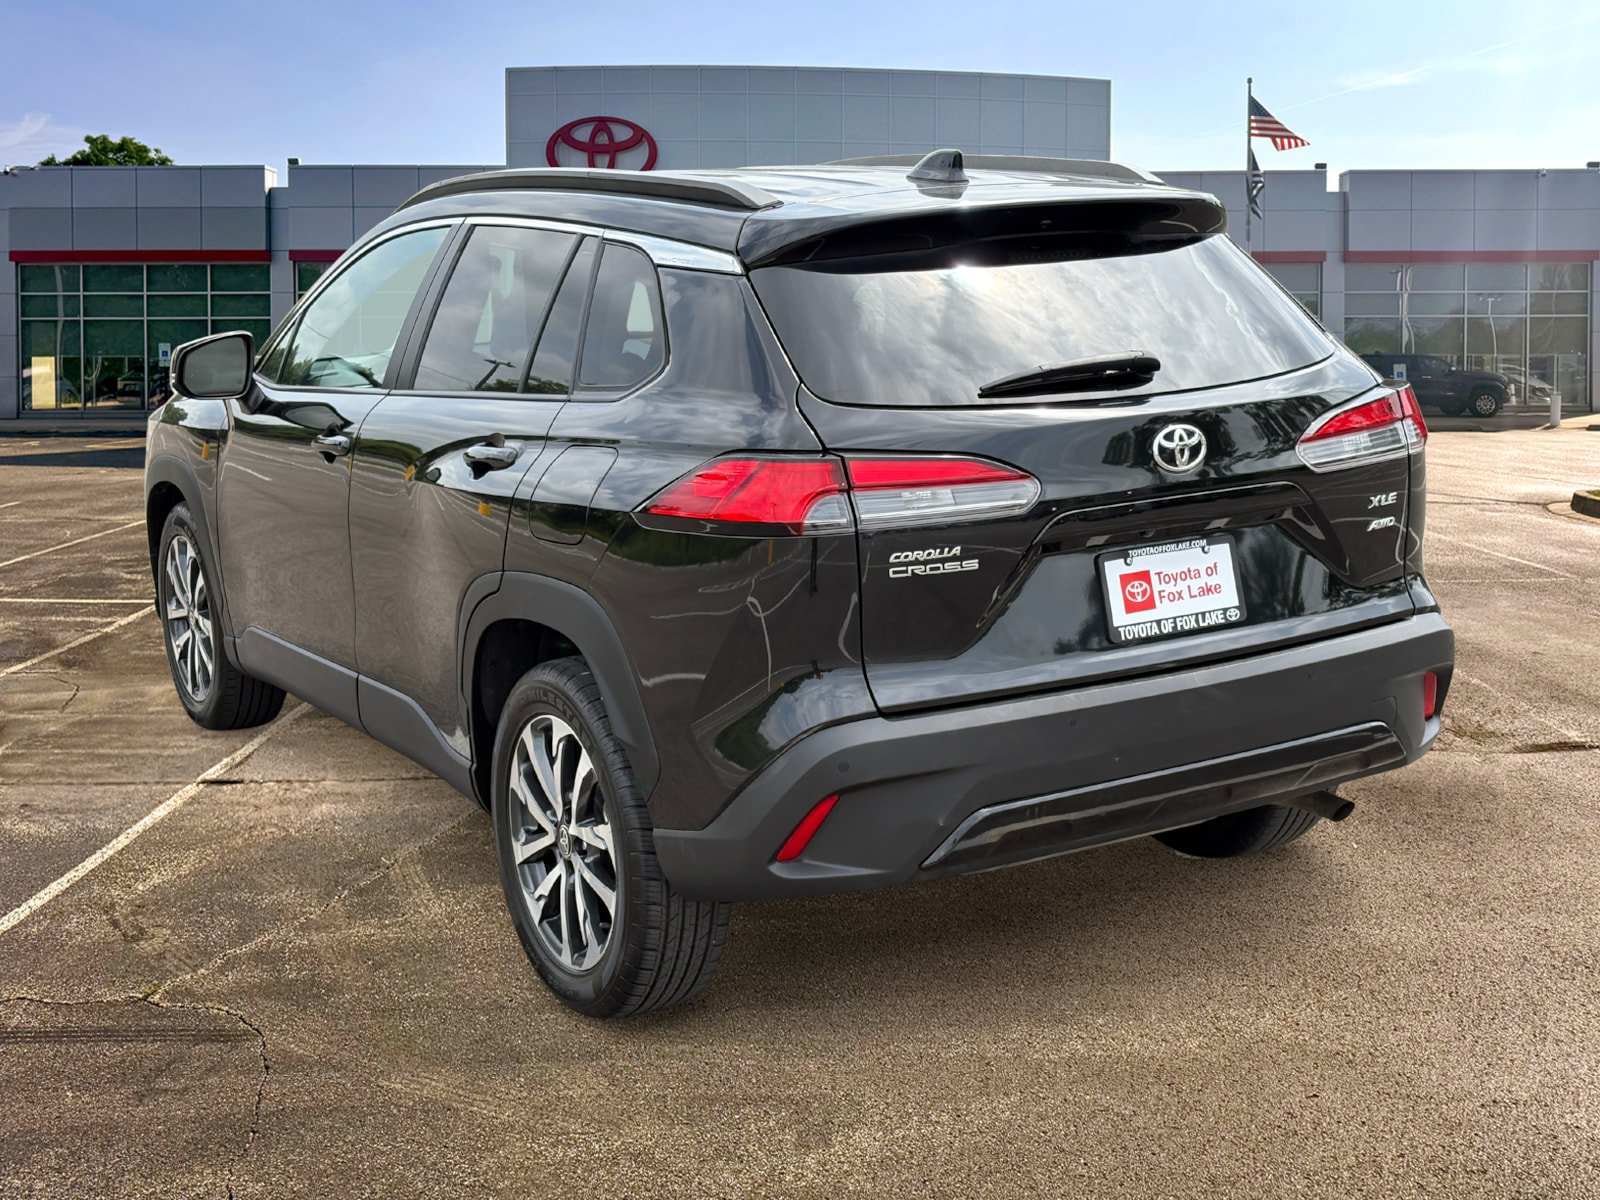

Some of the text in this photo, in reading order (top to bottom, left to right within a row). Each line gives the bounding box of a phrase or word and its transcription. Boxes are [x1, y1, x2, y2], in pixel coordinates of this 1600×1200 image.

[1368, 492, 1397, 509] XLE
[889, 546, 961, 563] COROLLA
[1128, 539, 1207, 557] TOYOTAOFFOXLAKE.COM
[889, 559, 979, 578] CROSS
[1155, 562, 1218, 587] Toyota of
[1158, 582, 1222, 604] Fox Lake
[1118, 610, 1225, 640] TOYOTA OF FOX LAKE
